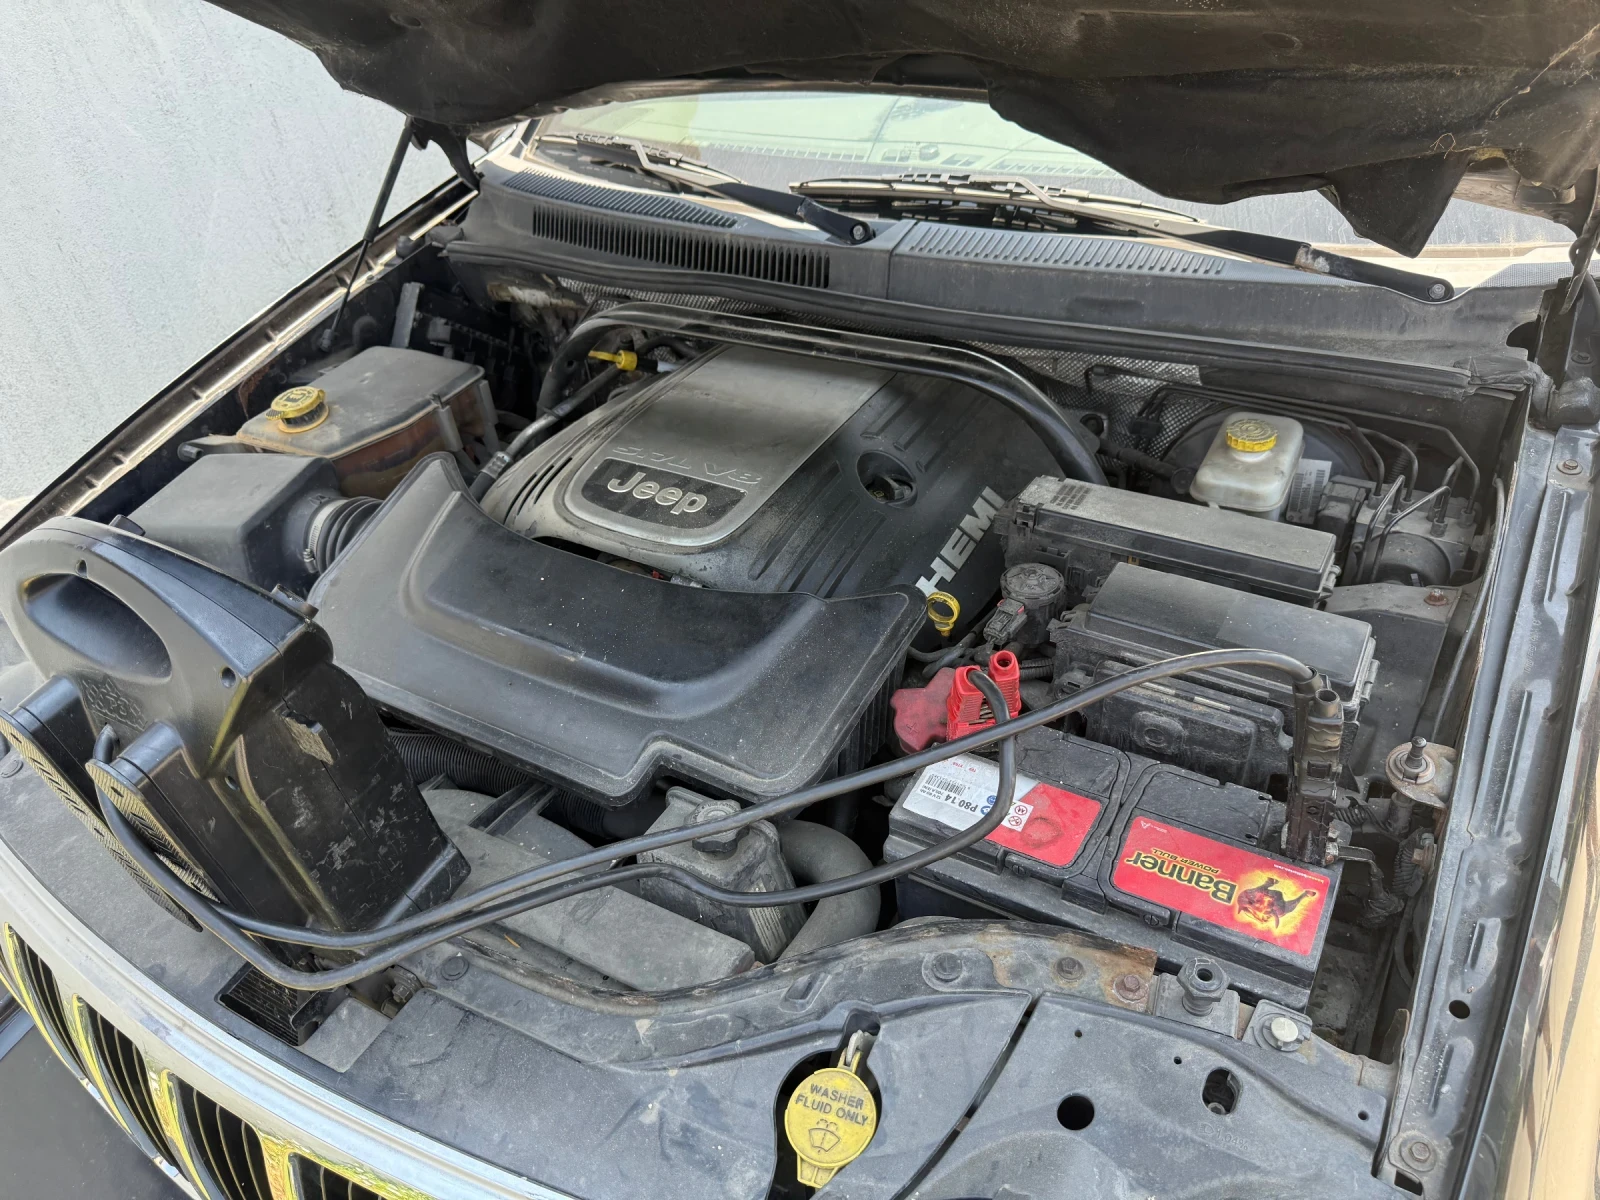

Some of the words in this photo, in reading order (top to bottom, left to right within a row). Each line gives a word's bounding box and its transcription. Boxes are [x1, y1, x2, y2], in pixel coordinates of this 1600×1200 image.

[704, 461, 763, 485] V8
[607, 471, 708, 516] Jeep
[915, 485, 1006, 597] HEMI
[1153, 848, 1178, 861] BULL
[1180, 858, 1219, 874] POWER
[1125, 851, 1237, 905] Banner
[795, 1094, 833, 1114] FLUID
[835, 1108, 869, 1126] ONLY
[810, 1083, 865, 1110] WASHER
